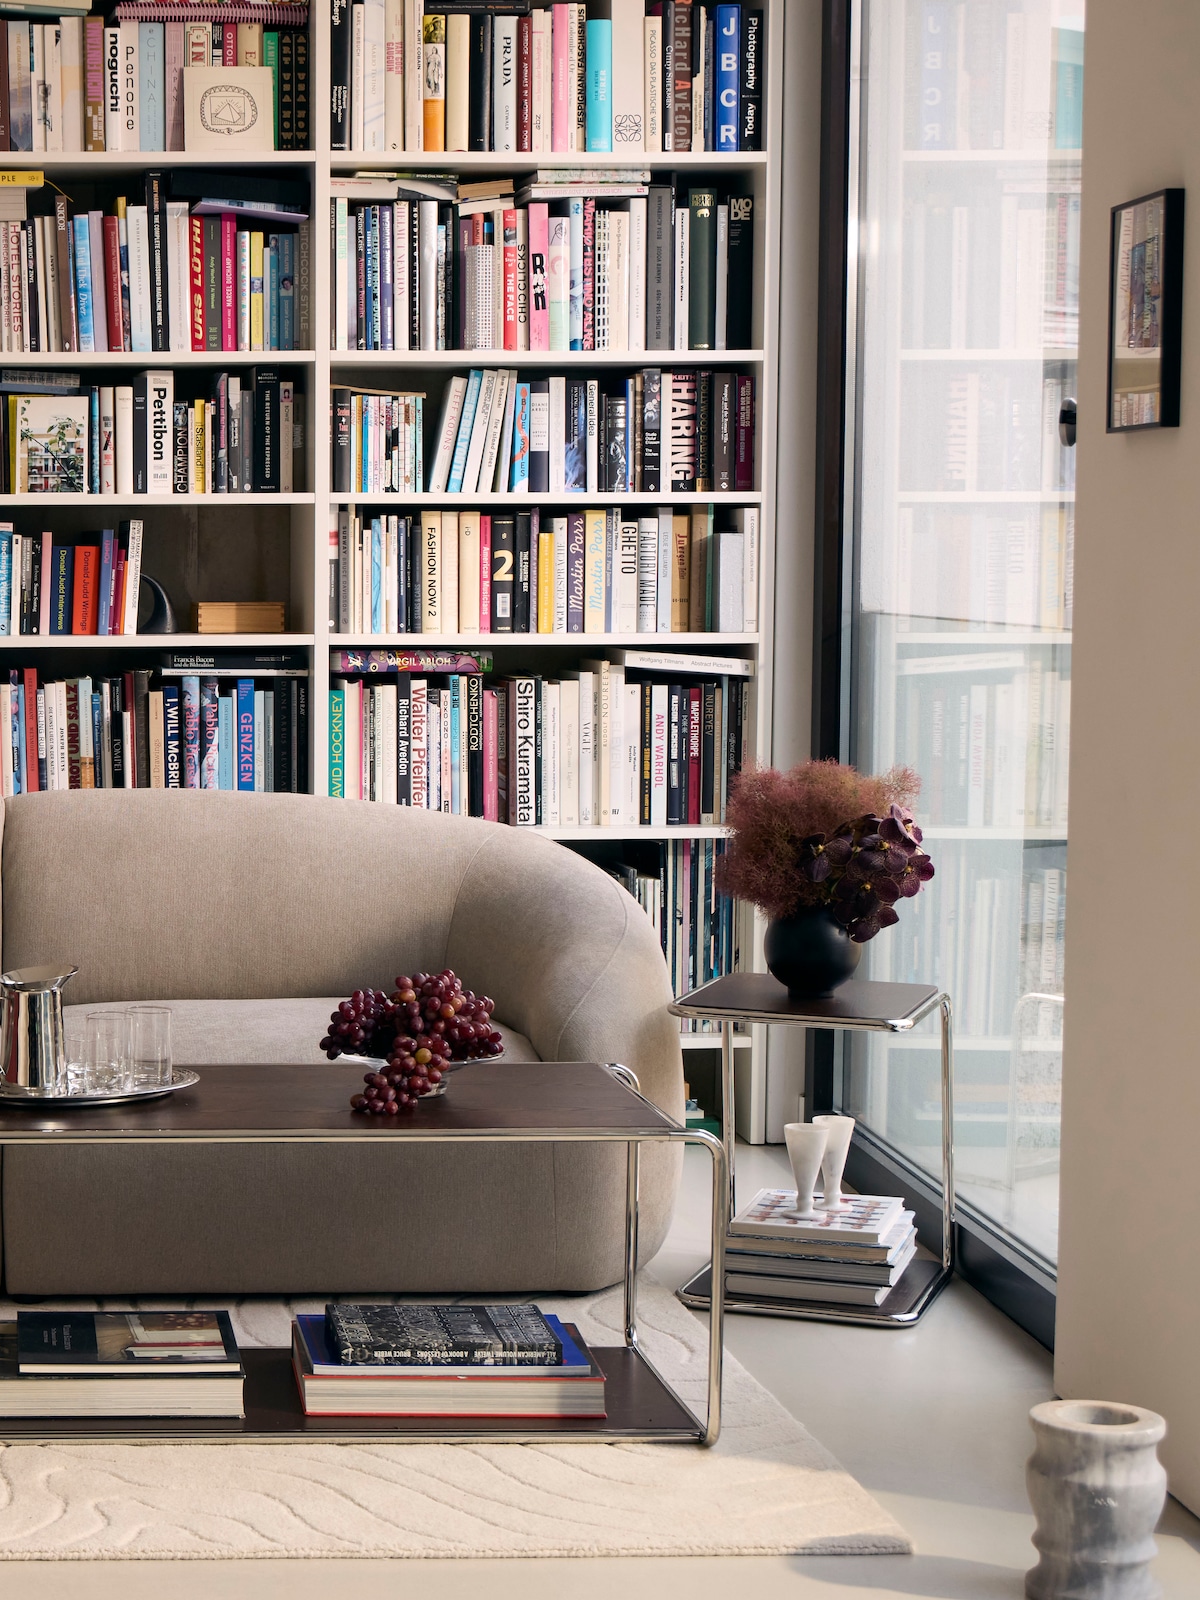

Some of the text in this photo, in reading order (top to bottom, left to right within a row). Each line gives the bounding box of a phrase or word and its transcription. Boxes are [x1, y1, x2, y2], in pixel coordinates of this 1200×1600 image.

[87, 22, 102, 101] LUCIO FONTANA
[108, 34, 120, 112] noguchi
[126, 47, 134, 130] Penone
[503, 36, 511, 86] PRADA
[664, 45, 673, 108] Cindy SHERMAN
[745, 17, 758, 137] Photography Today
[56, 202, 65, 231] RODIN
[10, 225, 21, 332] HOTEL STORIES
[300, 225, 308, 330] HITCHCOCK STYLE
[518, 244, 526, 323] CHIC CLICKS
[153, 388, 167, 460] Pettibon
[265, 426, 270, 434] OF
[588, 384, 596, 436] General Idea
[671, 382, 695, 481] HARING
[700, 377, 708, 477] HOLLYWOOD BABYLON
[177, 428, 187, 492] CHAMPION
[195, 427, 203, 467] Stasiland
[0, 541, 8, 581] Hockney's
[59, 550, 67, 575] Donald
[428, 527, 436, 575] FASHION
[493, 550, 514, 581] 2
[570, 518, 583, 610] Martin Parr
[622, 527, 637, 574] GHETTO
[640, 531, 656, 607] FACTORY MADE
[80, 601, 89, 631] Writings
[428, 579, 436, 607] NOW
[387, 657, 450, 666] VIRGIL ABLOH
[185, 704, 198, 788] Pablo Picasso
[205, 703, 218, 789] Pablo Picasso
[240, 712, 252, 782] GENZKEN
[399, 699, 409, 776] Richard Avedon
[412, 687, 425, 808] Walter Pfeiffer
[469, 678, 479, 751] RODTCHENKO
[582, 722, 591, 754] VOGUE
[671, 695, 679, 759] ALISON JACKSON
[705, 695, 714, 736] NUREYEV
[518, 682, 533, 822] Shiro Kuramata
[655, 714, 664, 788] ANDY WARHOL
